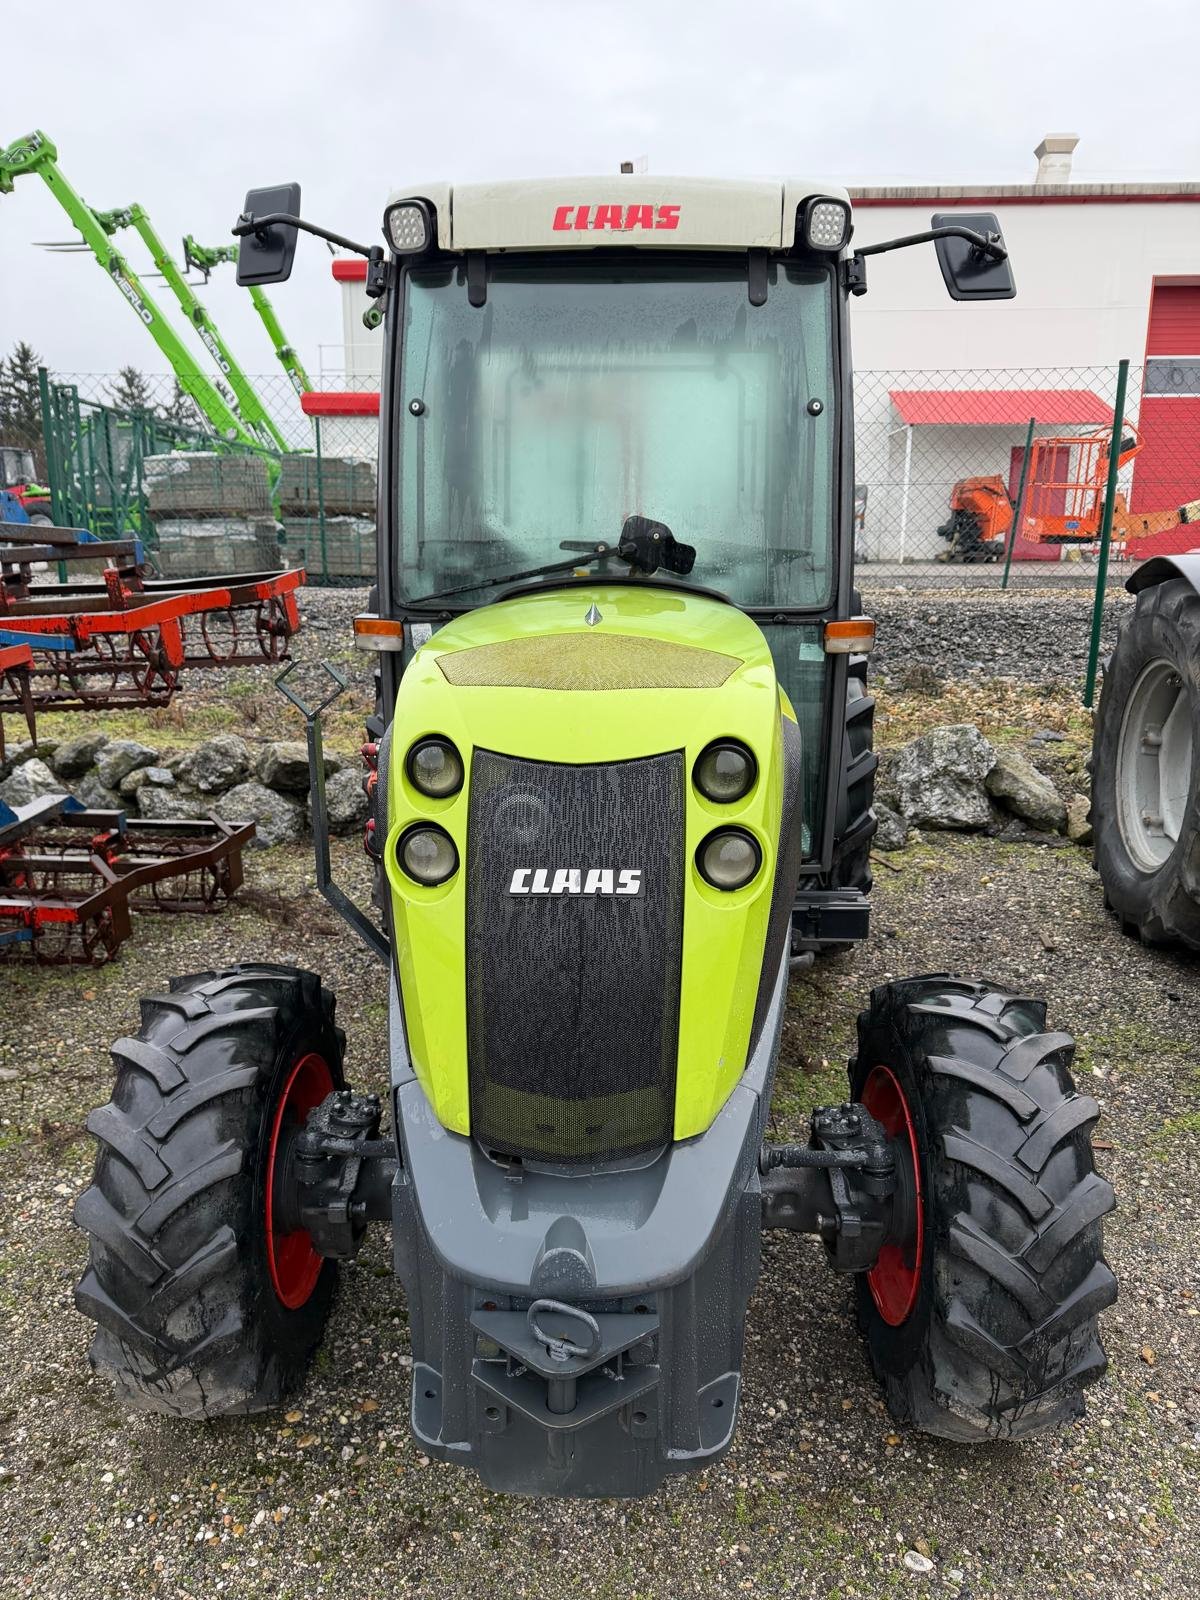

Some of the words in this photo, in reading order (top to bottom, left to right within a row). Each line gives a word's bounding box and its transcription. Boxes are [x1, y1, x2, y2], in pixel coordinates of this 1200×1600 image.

[552, 205, 681, 230] CLAAS
[111, 269, 153, 324] MERLO
[198, 326, 231, 374] MERLO
[509, 868, 642, 894] CLAAS
